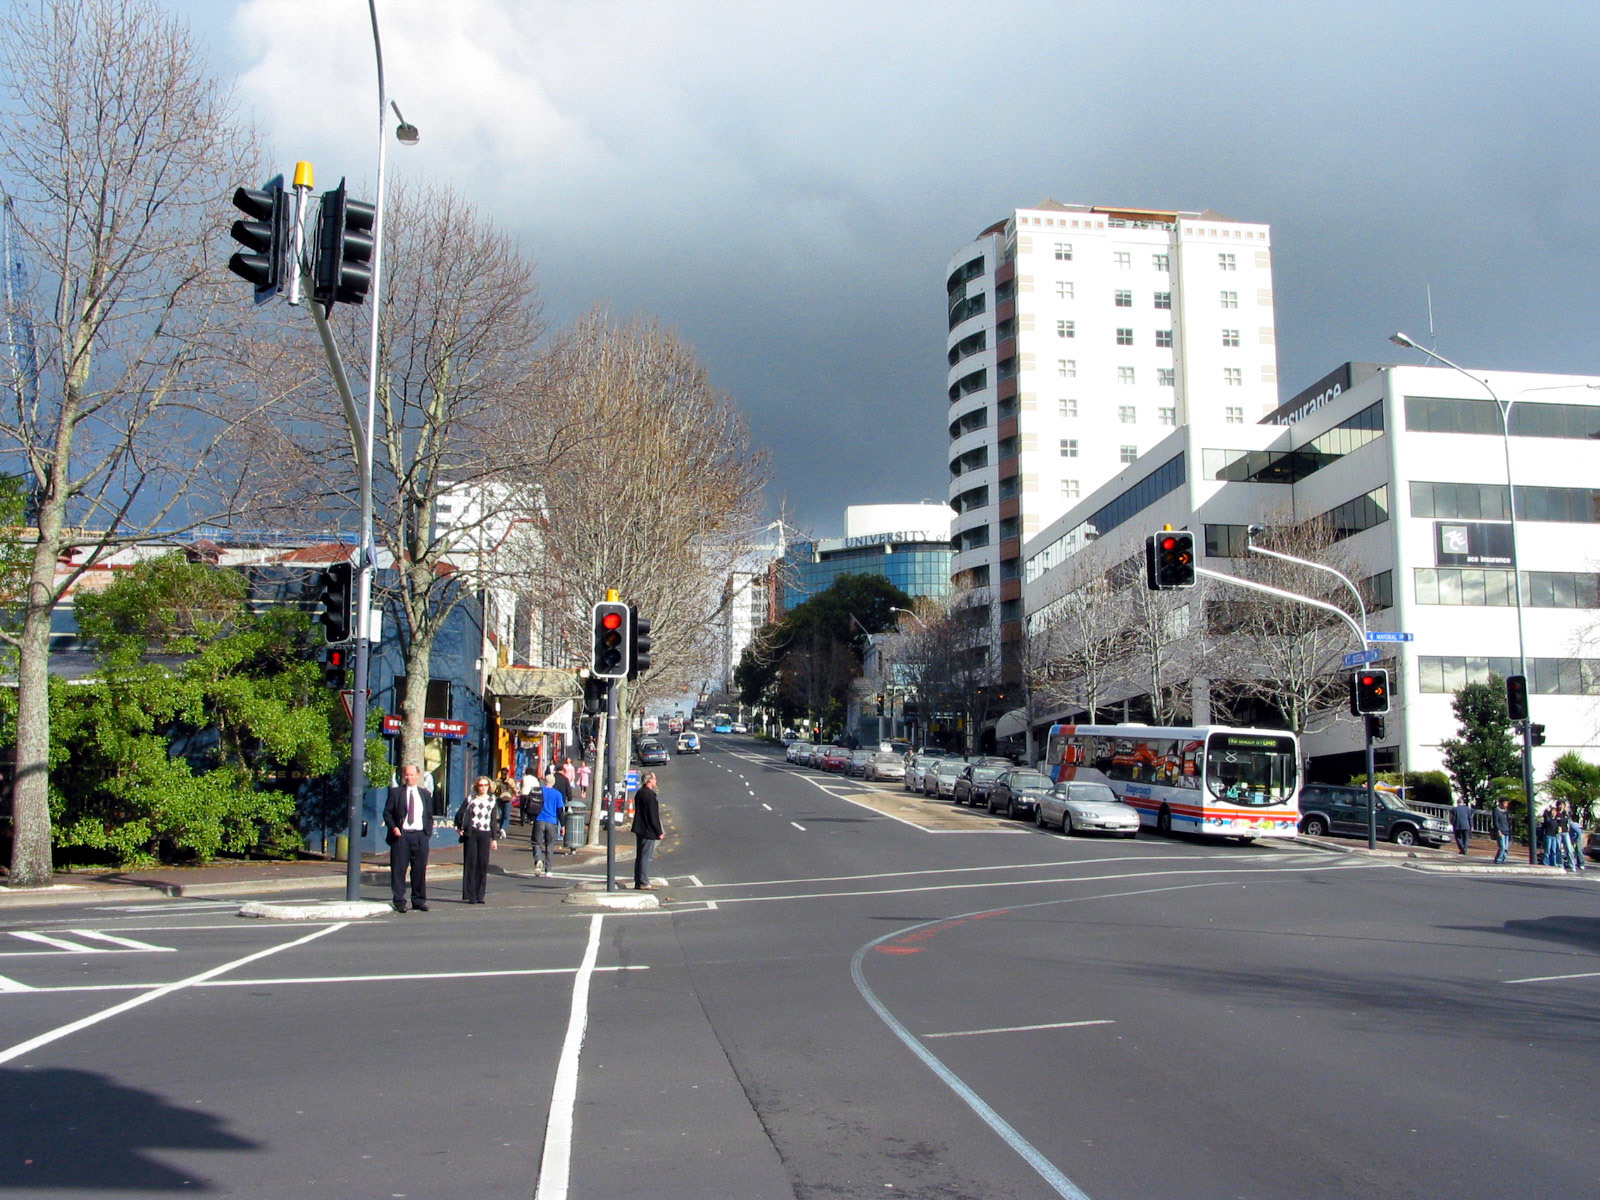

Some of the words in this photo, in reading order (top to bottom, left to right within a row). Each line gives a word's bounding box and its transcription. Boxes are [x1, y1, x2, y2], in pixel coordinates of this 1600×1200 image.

[845, 530, 930, 548] UNIVERSITY
[1480, 555, 1511, 564] insurance
[440, 721, 464, 731] bar
[548, 722, 568, 730] HOSTEL
